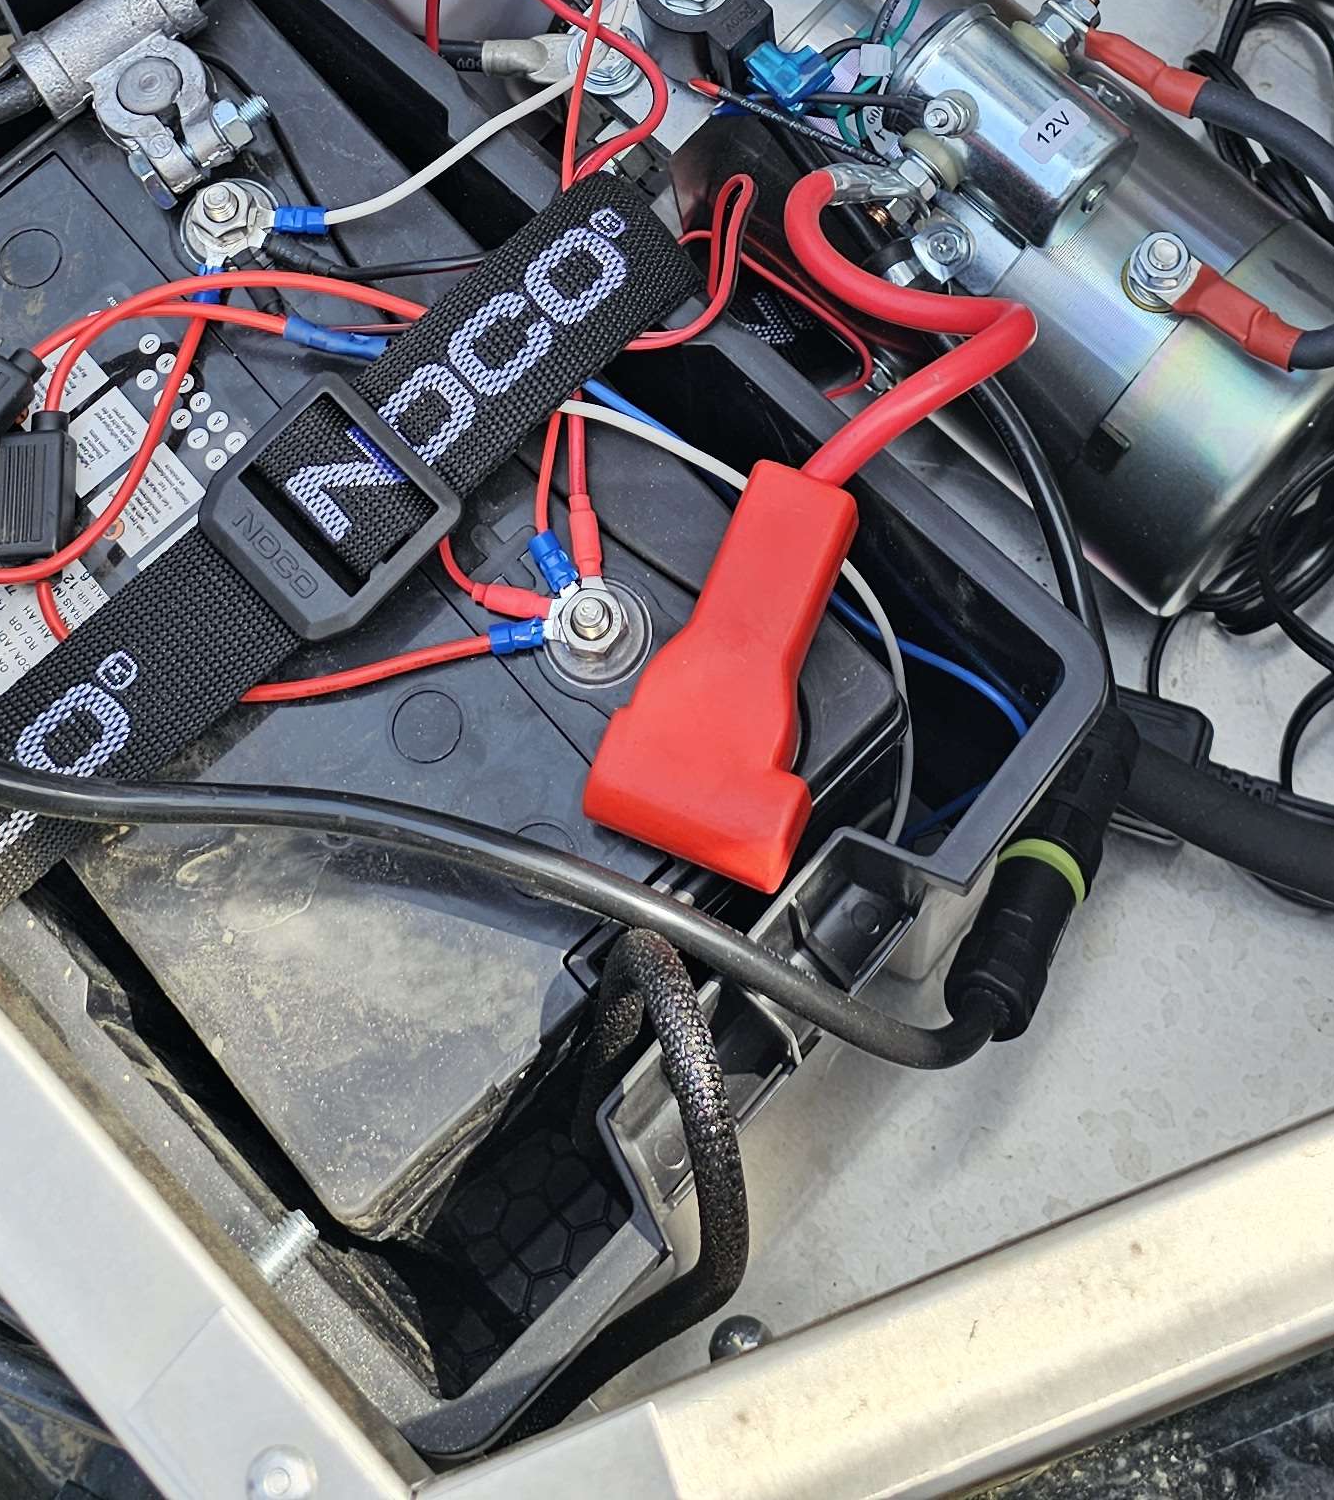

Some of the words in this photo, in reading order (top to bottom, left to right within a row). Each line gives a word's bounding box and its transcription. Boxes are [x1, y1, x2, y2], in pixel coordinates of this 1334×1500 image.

[1034, 109, 1071, 146] 12V
[285, 227, 628, 542] NOCO
[230, 505, 322, 602] NOCO
[61, 572, 80, 592] 12
[78, 569, 92, 583] 6
[21, 604, 37, 620] AH
[36, 622, 53, 640] AH
